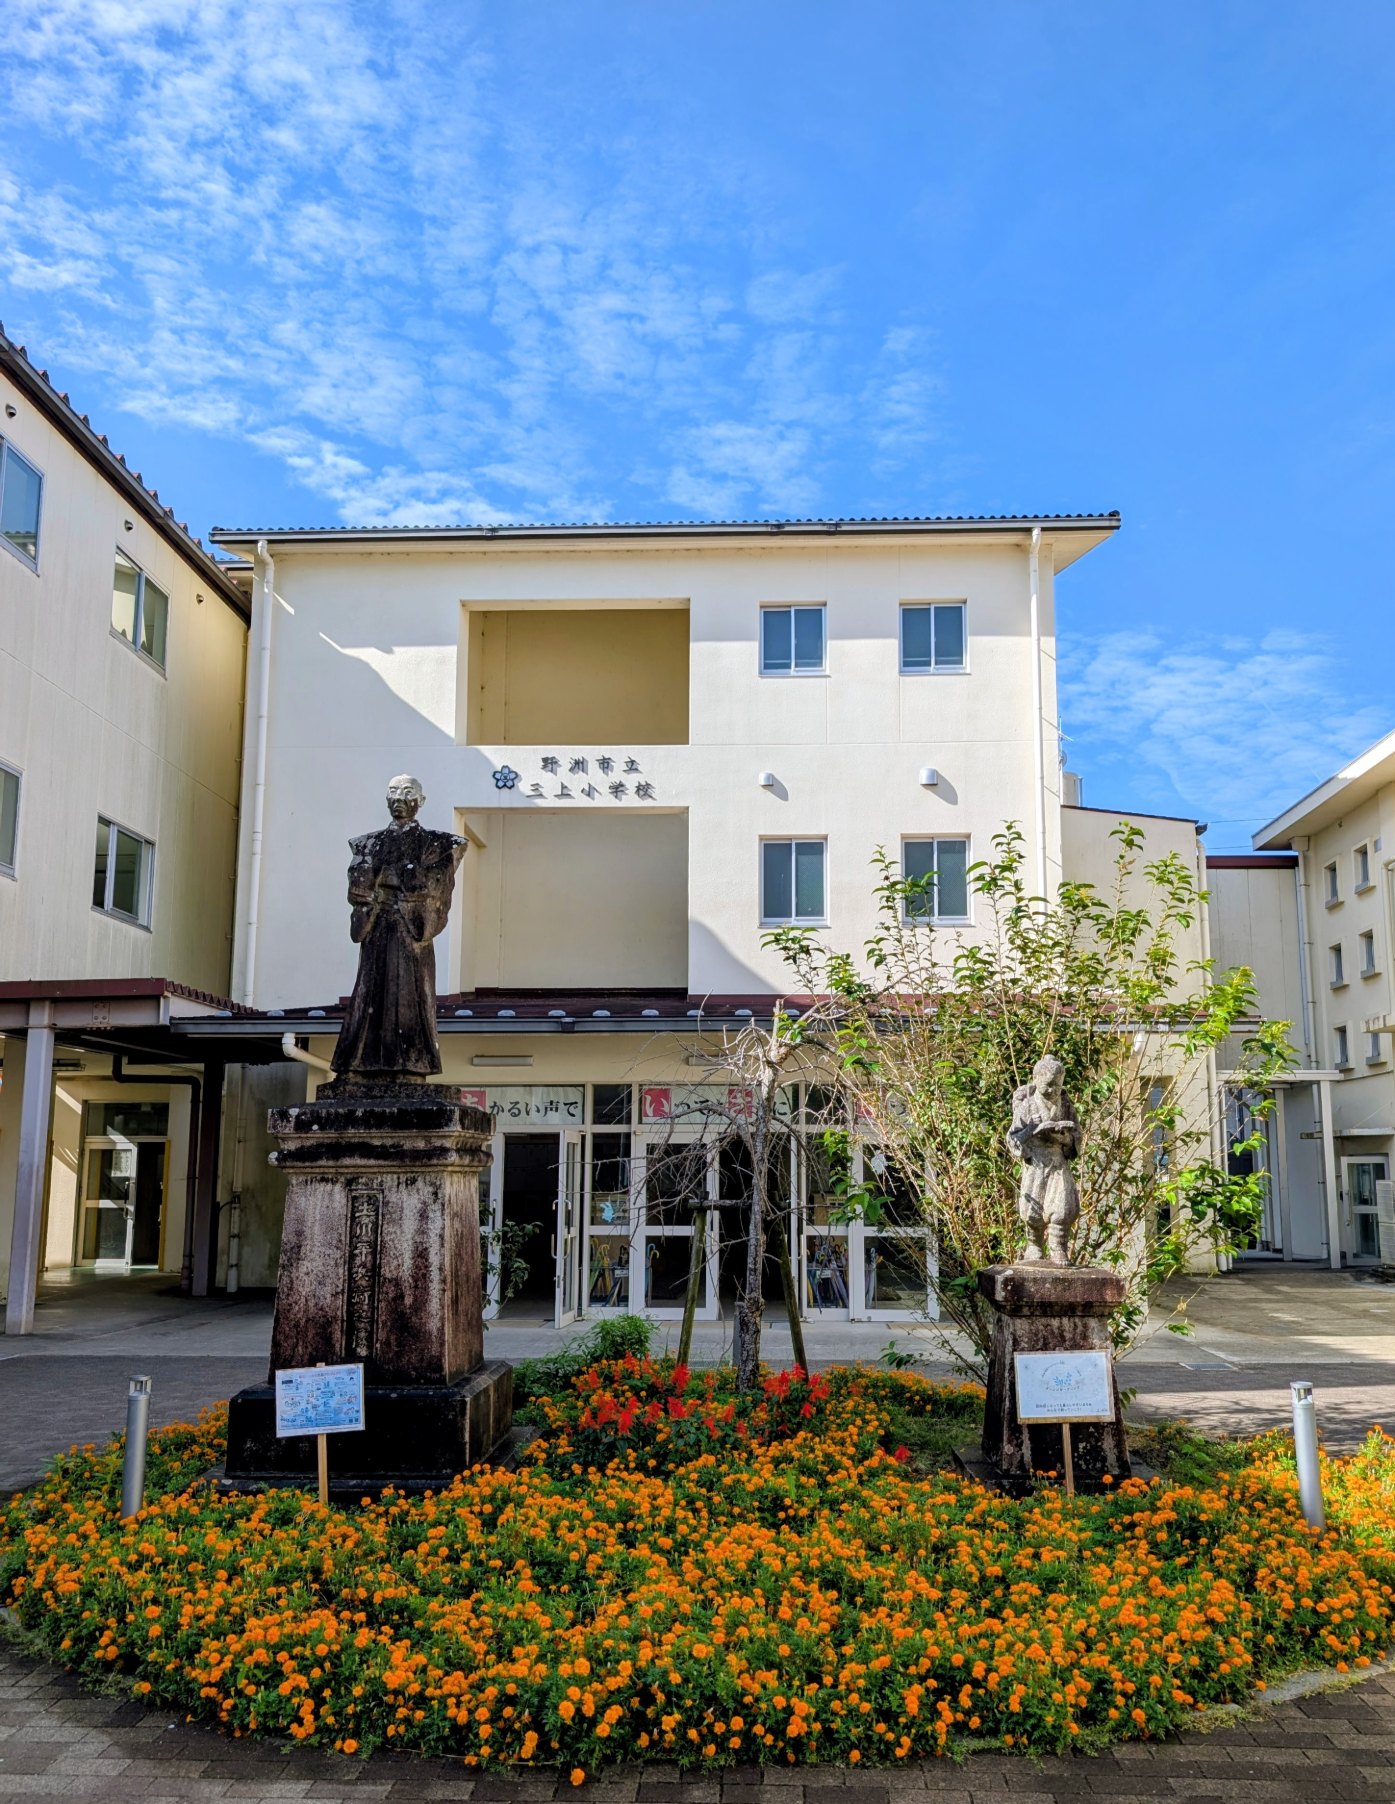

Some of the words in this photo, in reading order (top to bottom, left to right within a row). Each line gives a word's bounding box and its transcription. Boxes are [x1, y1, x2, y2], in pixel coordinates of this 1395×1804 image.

[541, 755, 641, 775] 野洲市立
[527, 780, 655, 800] 三上小学校
